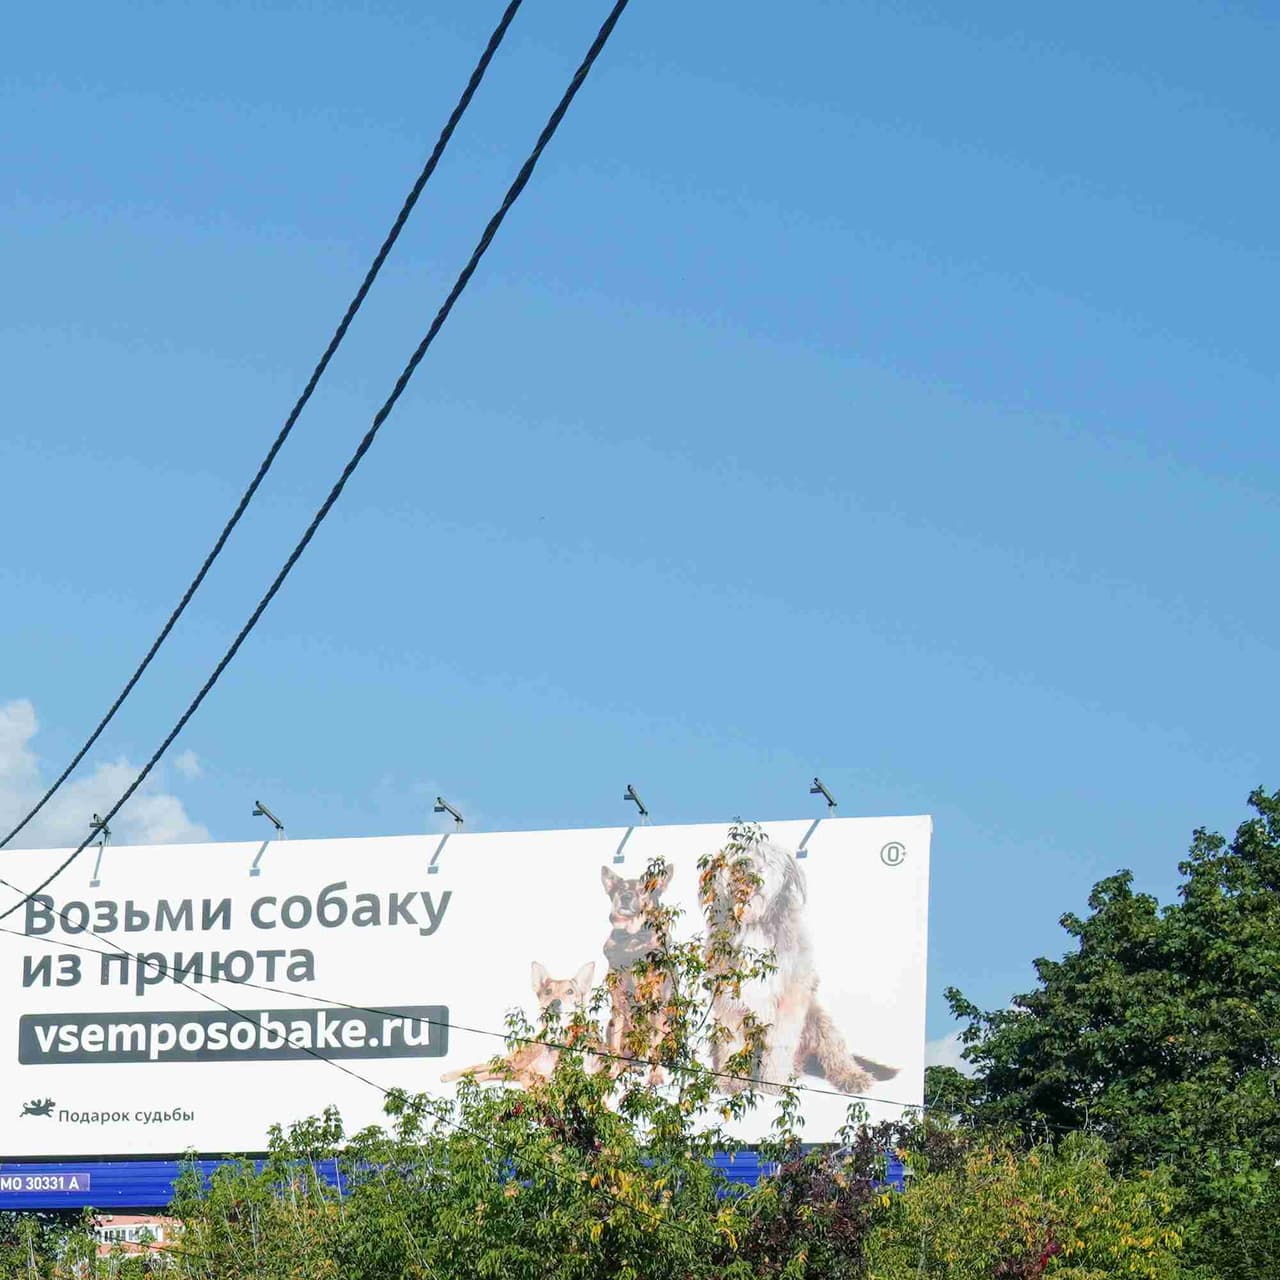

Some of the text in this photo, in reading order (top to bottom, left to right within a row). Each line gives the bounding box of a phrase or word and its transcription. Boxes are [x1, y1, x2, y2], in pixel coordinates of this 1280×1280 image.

[24, 880, 453, 937] Возьми собаку
[21, 947, 316, 996] из приюта
[33, 1011, 431, 1060] vsemposobake.ru
[59, 1107, 195, 1125] Подарок судьбы
[25, 1176, 65, 1190] 30331
